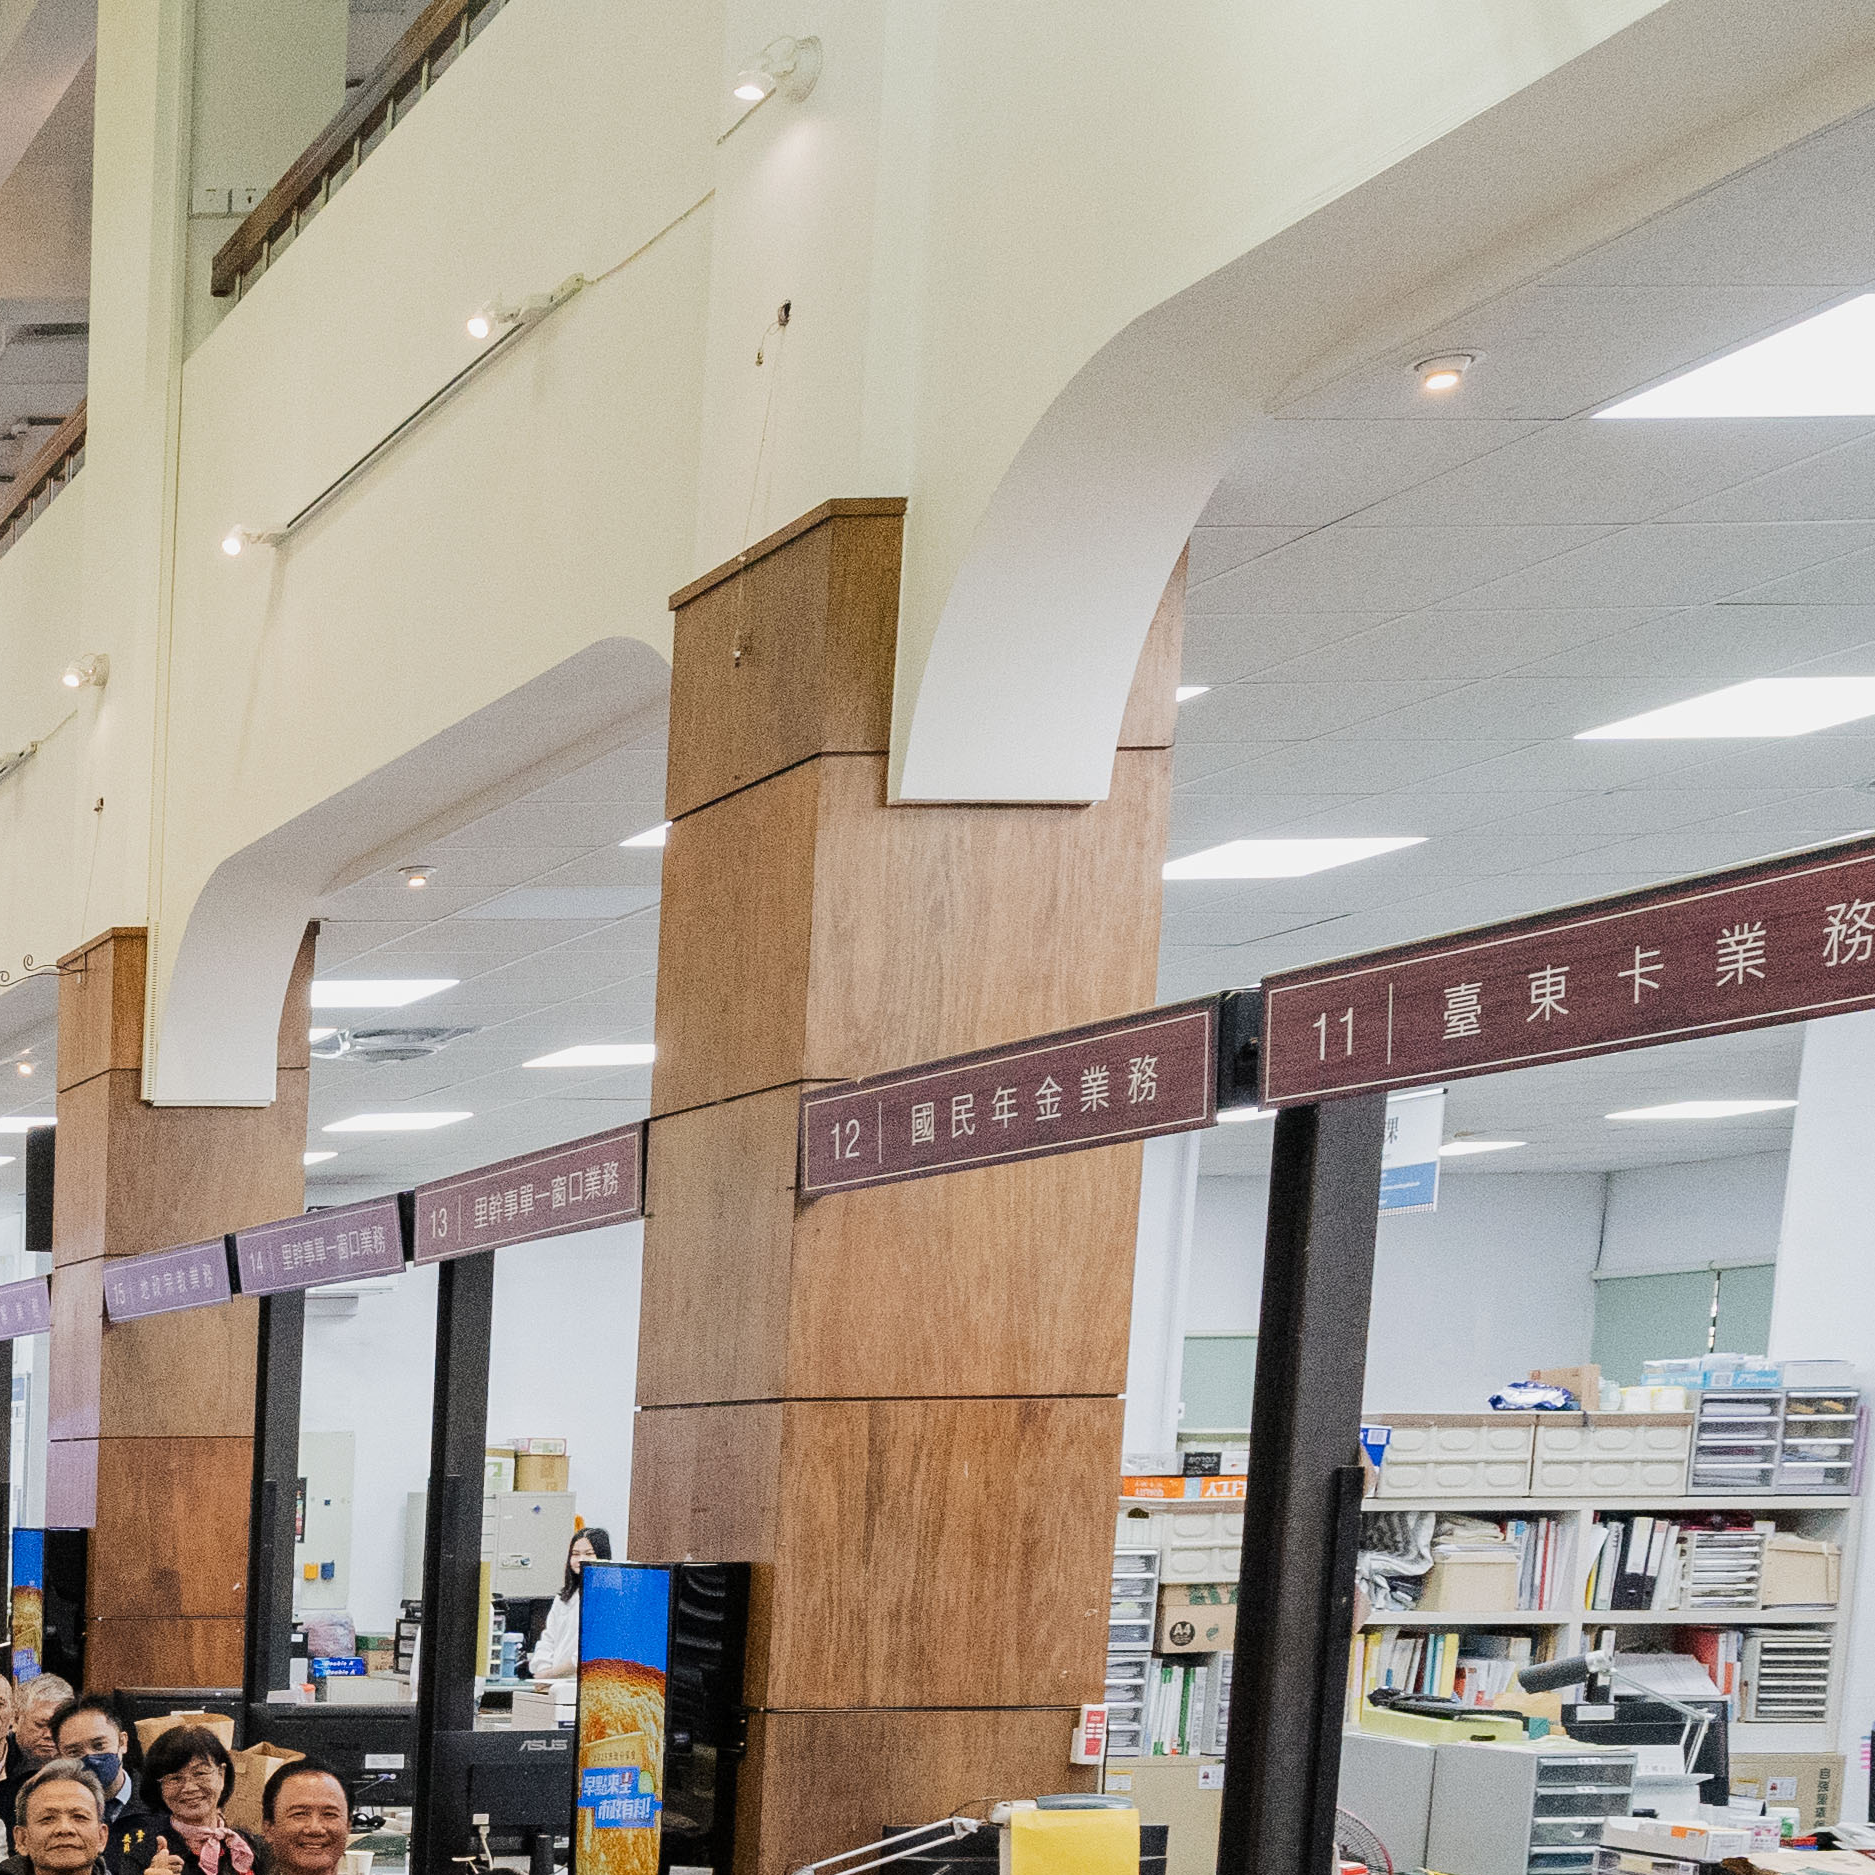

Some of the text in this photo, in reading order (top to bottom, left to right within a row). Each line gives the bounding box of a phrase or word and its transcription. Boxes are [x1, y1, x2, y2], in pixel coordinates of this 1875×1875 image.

[1311, 896, 1875, 1064] 11 臺東卡業務
[829, 1054, 1161, 1162] 12 國民年金業務
[429, 1162, 622, 1241] 13 里幹事單一窗口業務
[250, 1250, 264, 1276] 14
[113, 1282, 126, 1306] 15
[1175, 1622, 1192, 1634] A4
[519, 1739, 568, 1751] ASUS
